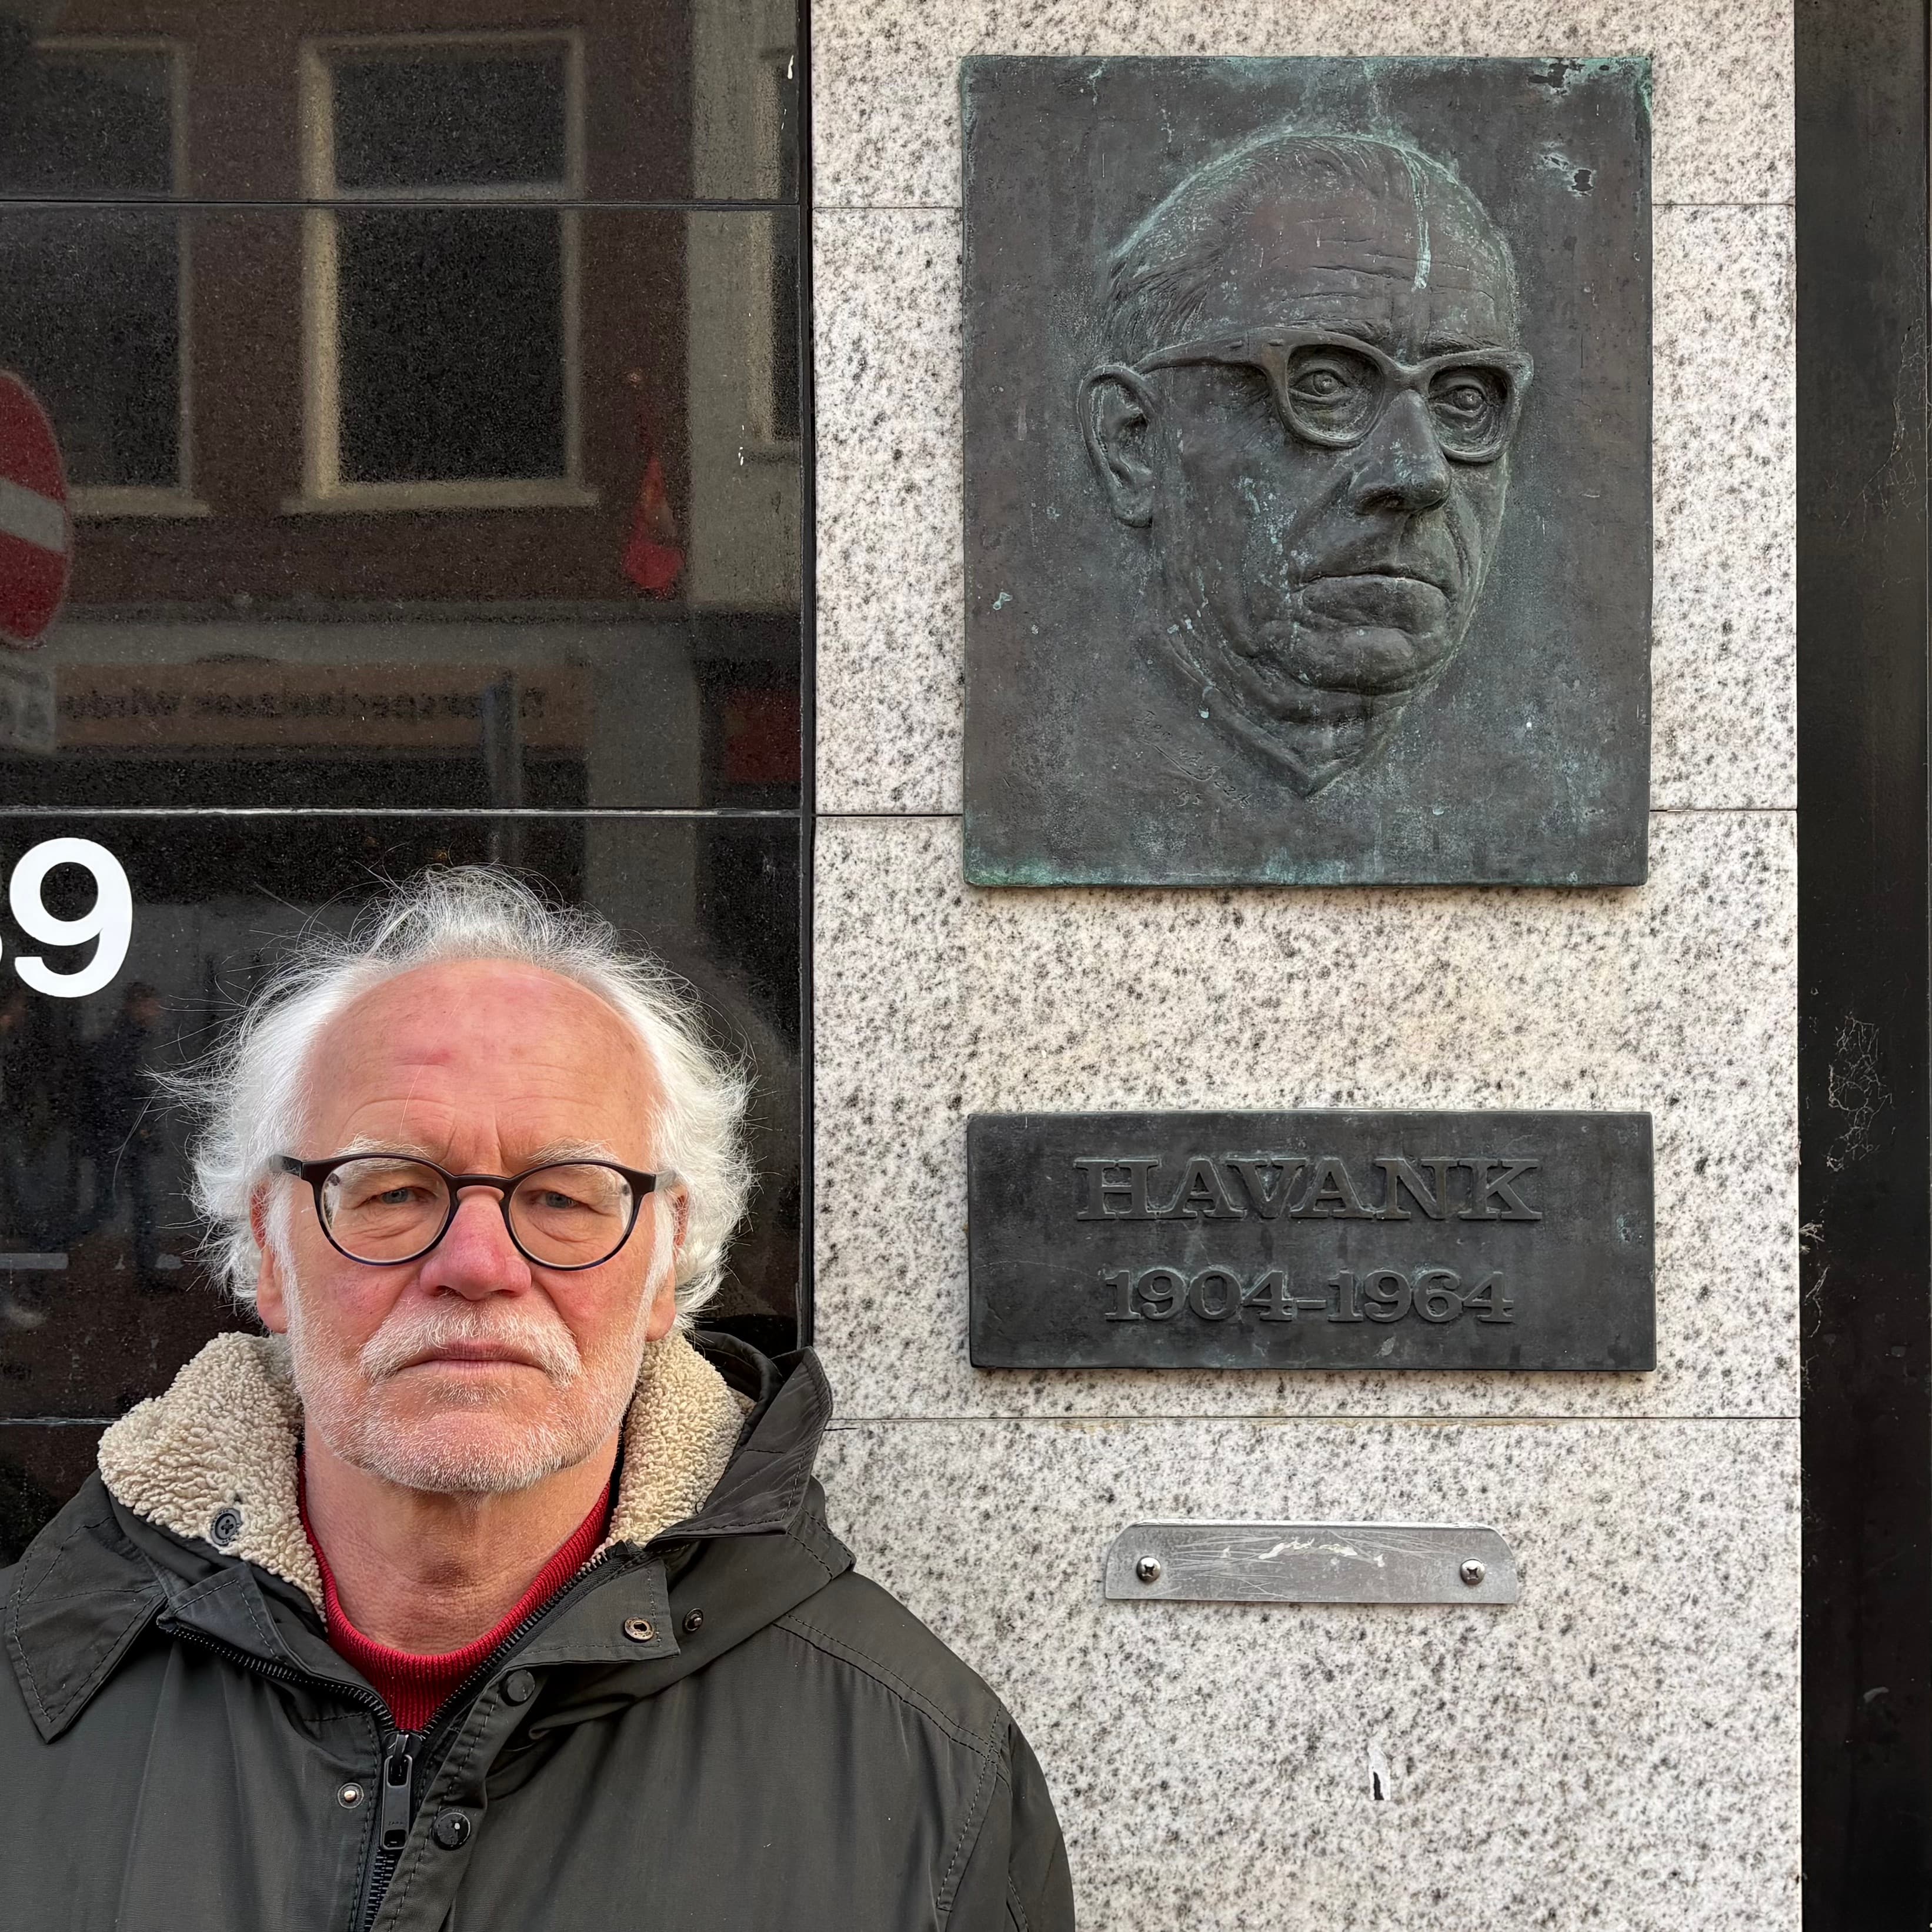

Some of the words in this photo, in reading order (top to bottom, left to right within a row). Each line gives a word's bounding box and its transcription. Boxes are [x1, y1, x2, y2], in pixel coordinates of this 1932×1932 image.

[0, 837, 133, 998] 9
[1073, 1157, 1543, 1222] HAVANK
[1104, 1267, 1514, 1323] 1904-1964
